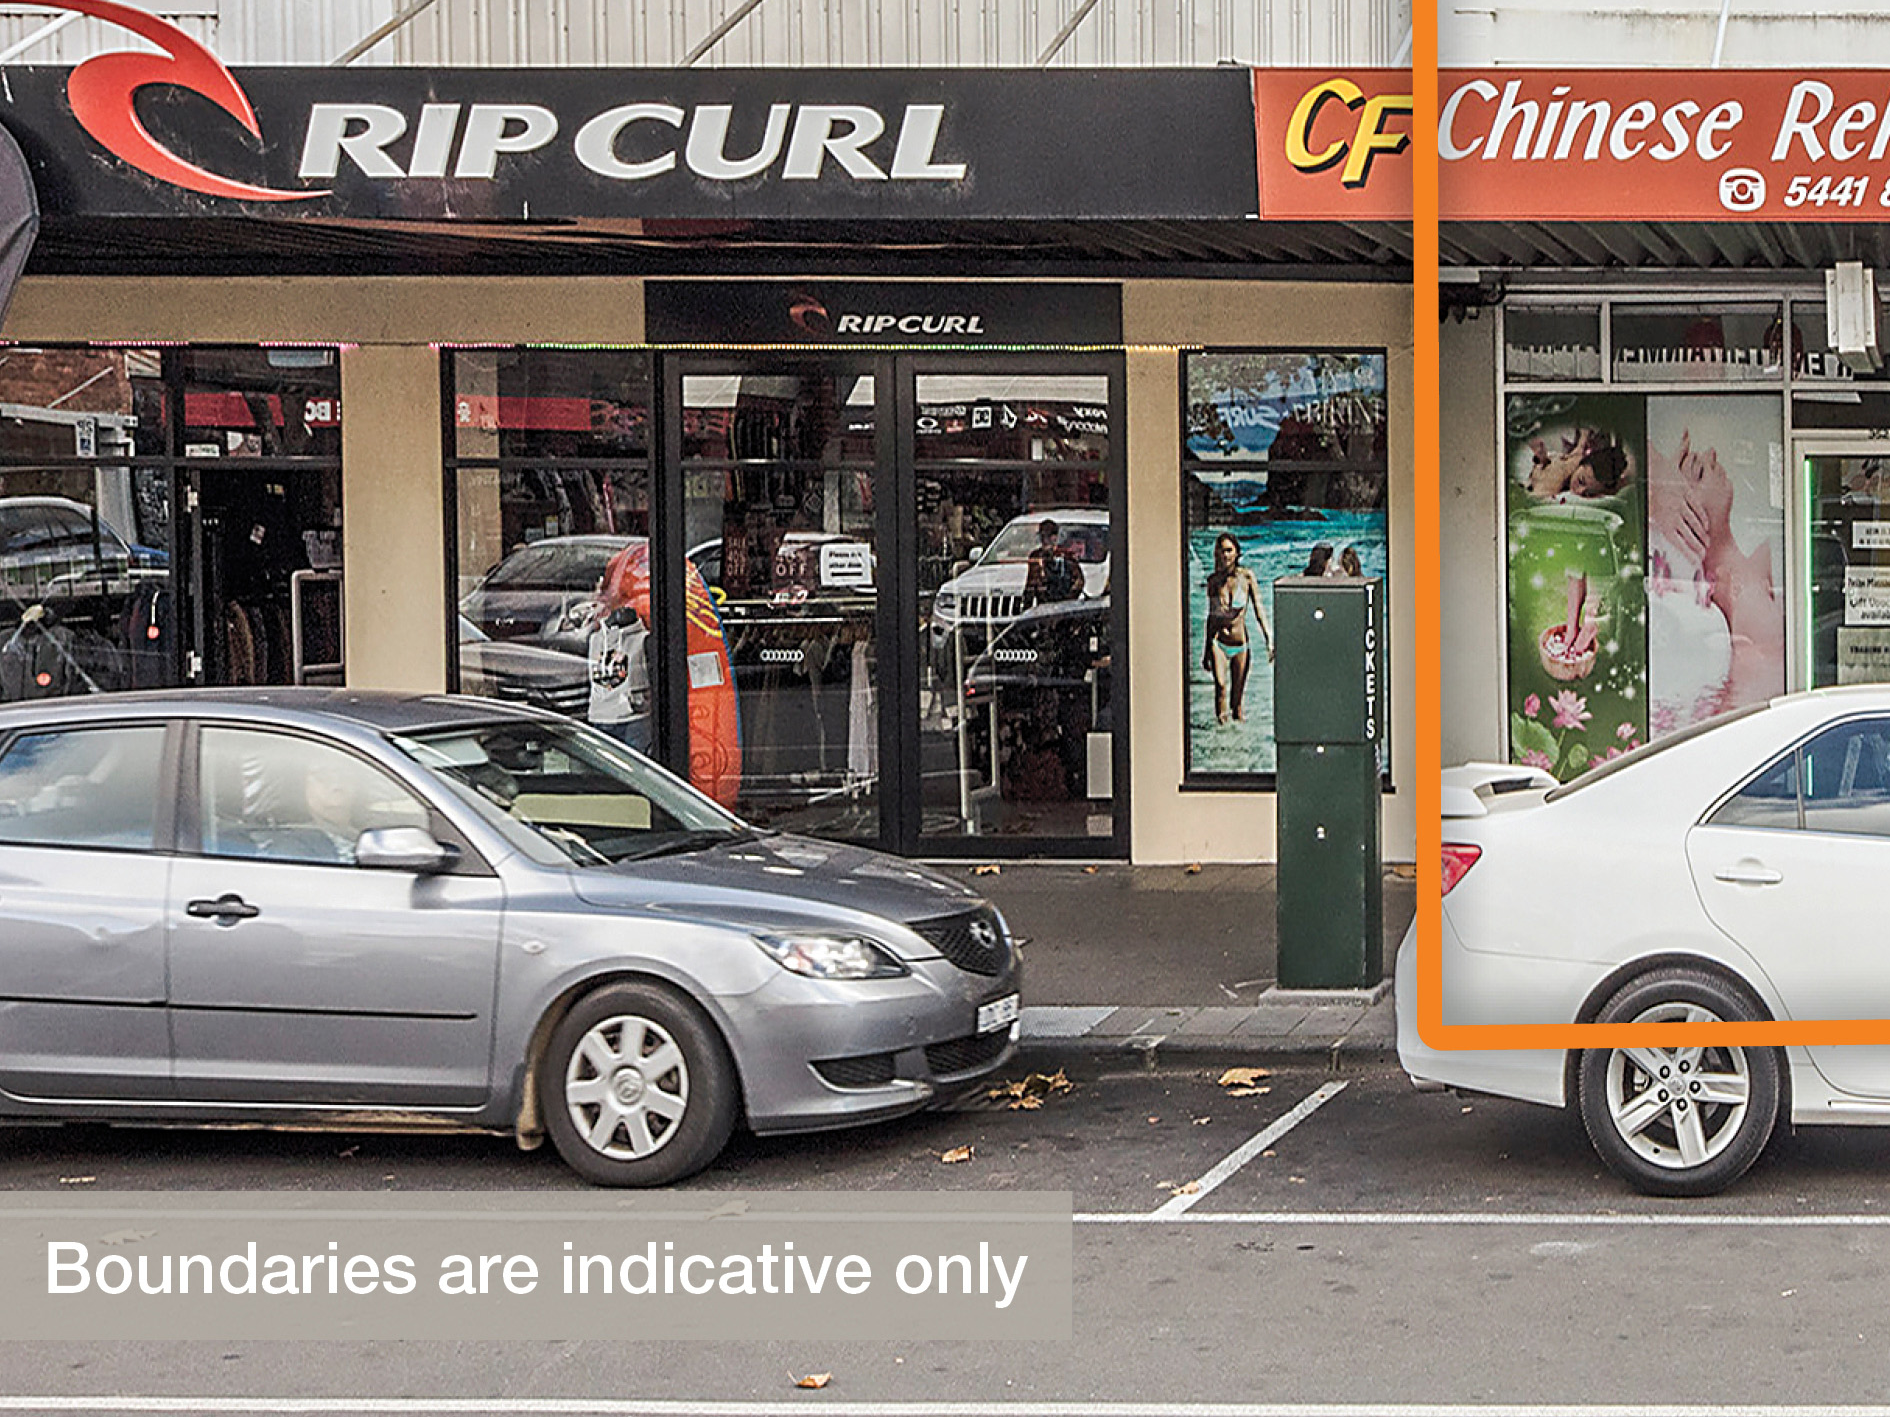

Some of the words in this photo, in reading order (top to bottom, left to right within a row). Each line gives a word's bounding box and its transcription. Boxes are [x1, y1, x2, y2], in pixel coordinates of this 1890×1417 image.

[298, 103, 559, 180] RIP
[574, 103, 967, 180] CURL
[1437, 79, 1743, 162] Chinese
[1784, 175, 1869, 207] 5441
[837, 315, 895, 335] RIP
[897, 315, 984, 334] CURL
[1363, 584, 1377, 740] TICKETS
